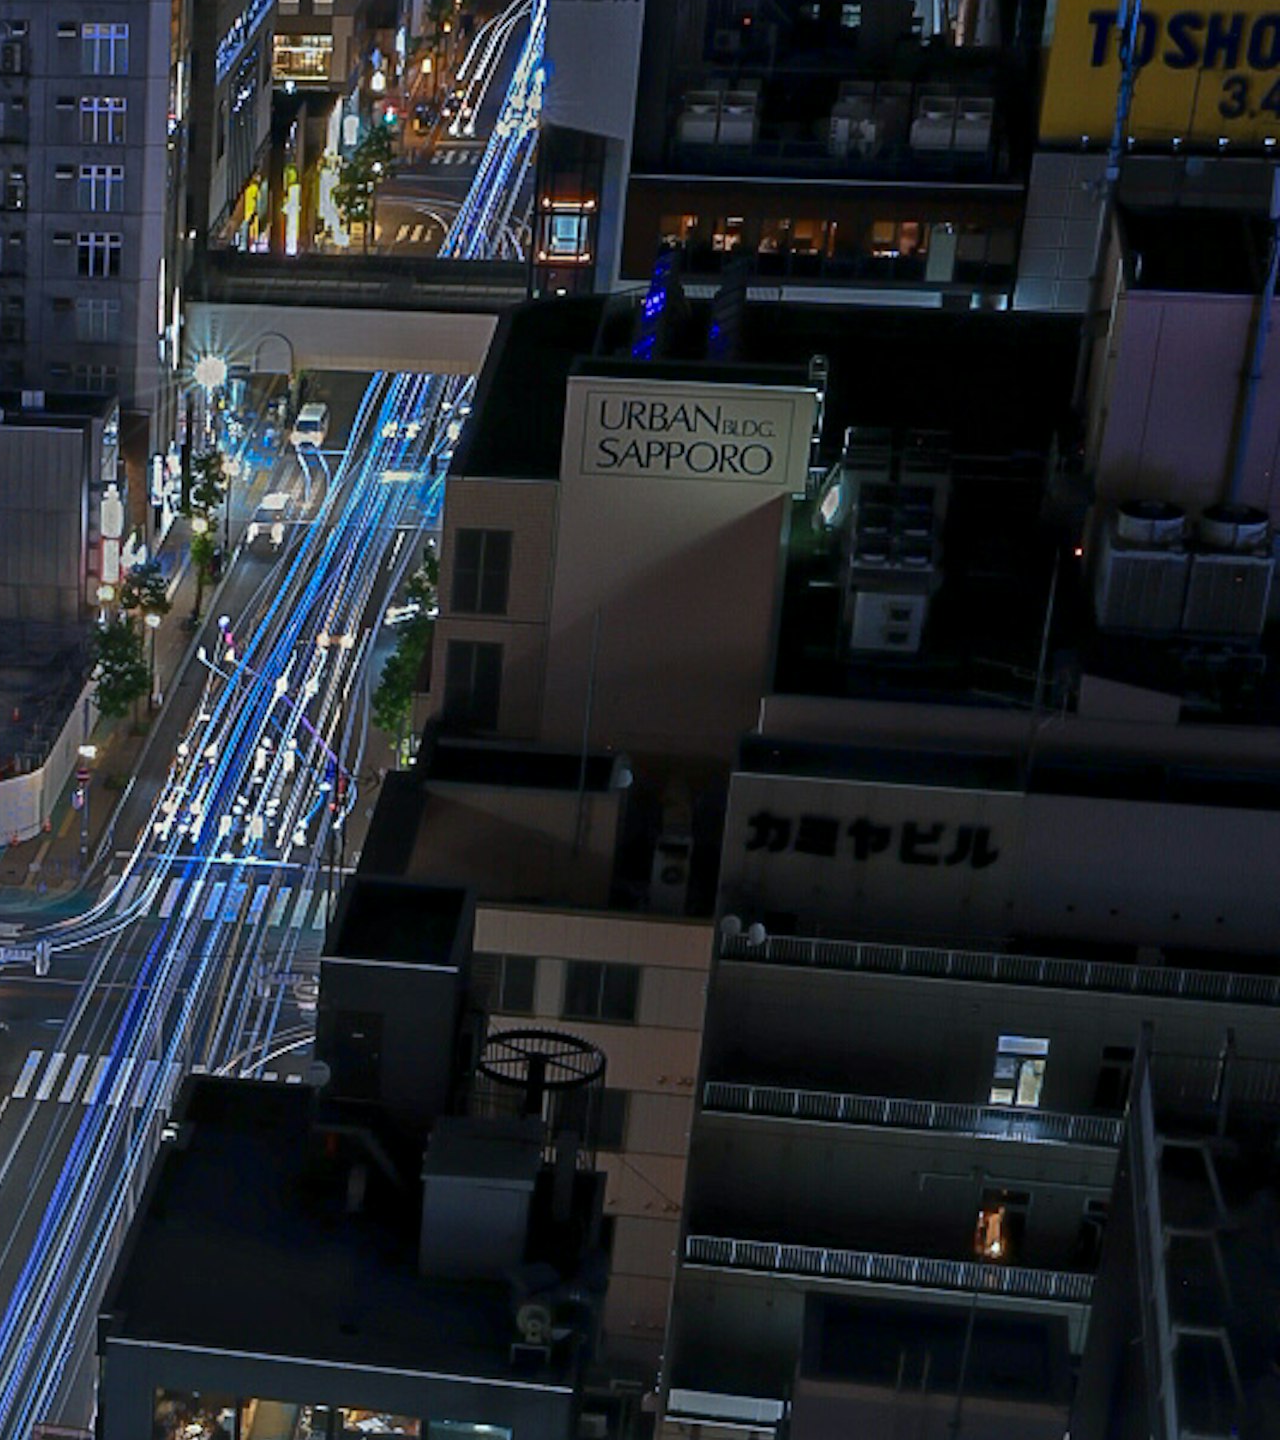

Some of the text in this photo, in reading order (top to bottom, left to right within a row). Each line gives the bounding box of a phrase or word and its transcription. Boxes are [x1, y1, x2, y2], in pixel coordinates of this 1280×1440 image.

[600, 400, 722, 434] URBAN
[596, 436, 774, 476] SAPPORO
[745, 810, 1000, 868] カミヤビル
